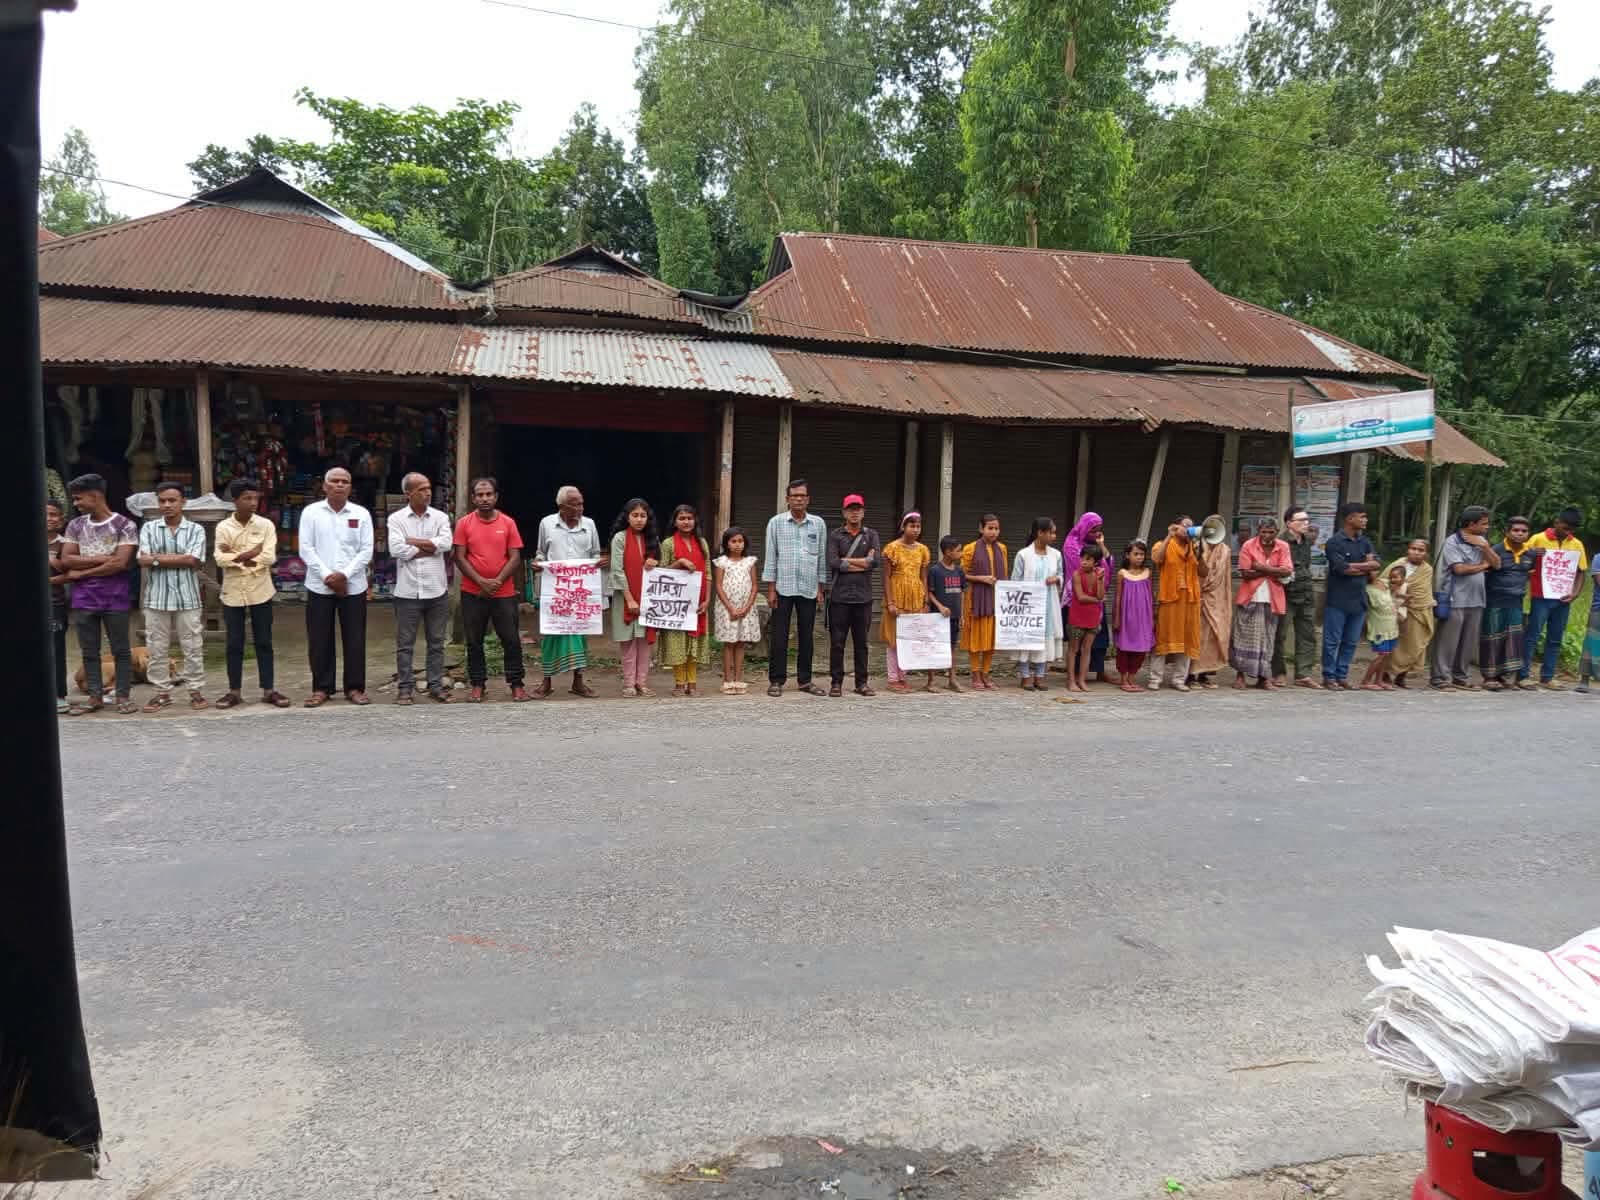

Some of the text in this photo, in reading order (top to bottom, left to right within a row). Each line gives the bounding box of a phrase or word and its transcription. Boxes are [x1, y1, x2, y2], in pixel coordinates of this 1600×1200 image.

[1006, 591, 1032, 605] WE
[648, 599, 691, 618] হত্যার
[1000, 605, 1035, 615] WANT
[1000, 616, 1043, 628] JUSTICE
